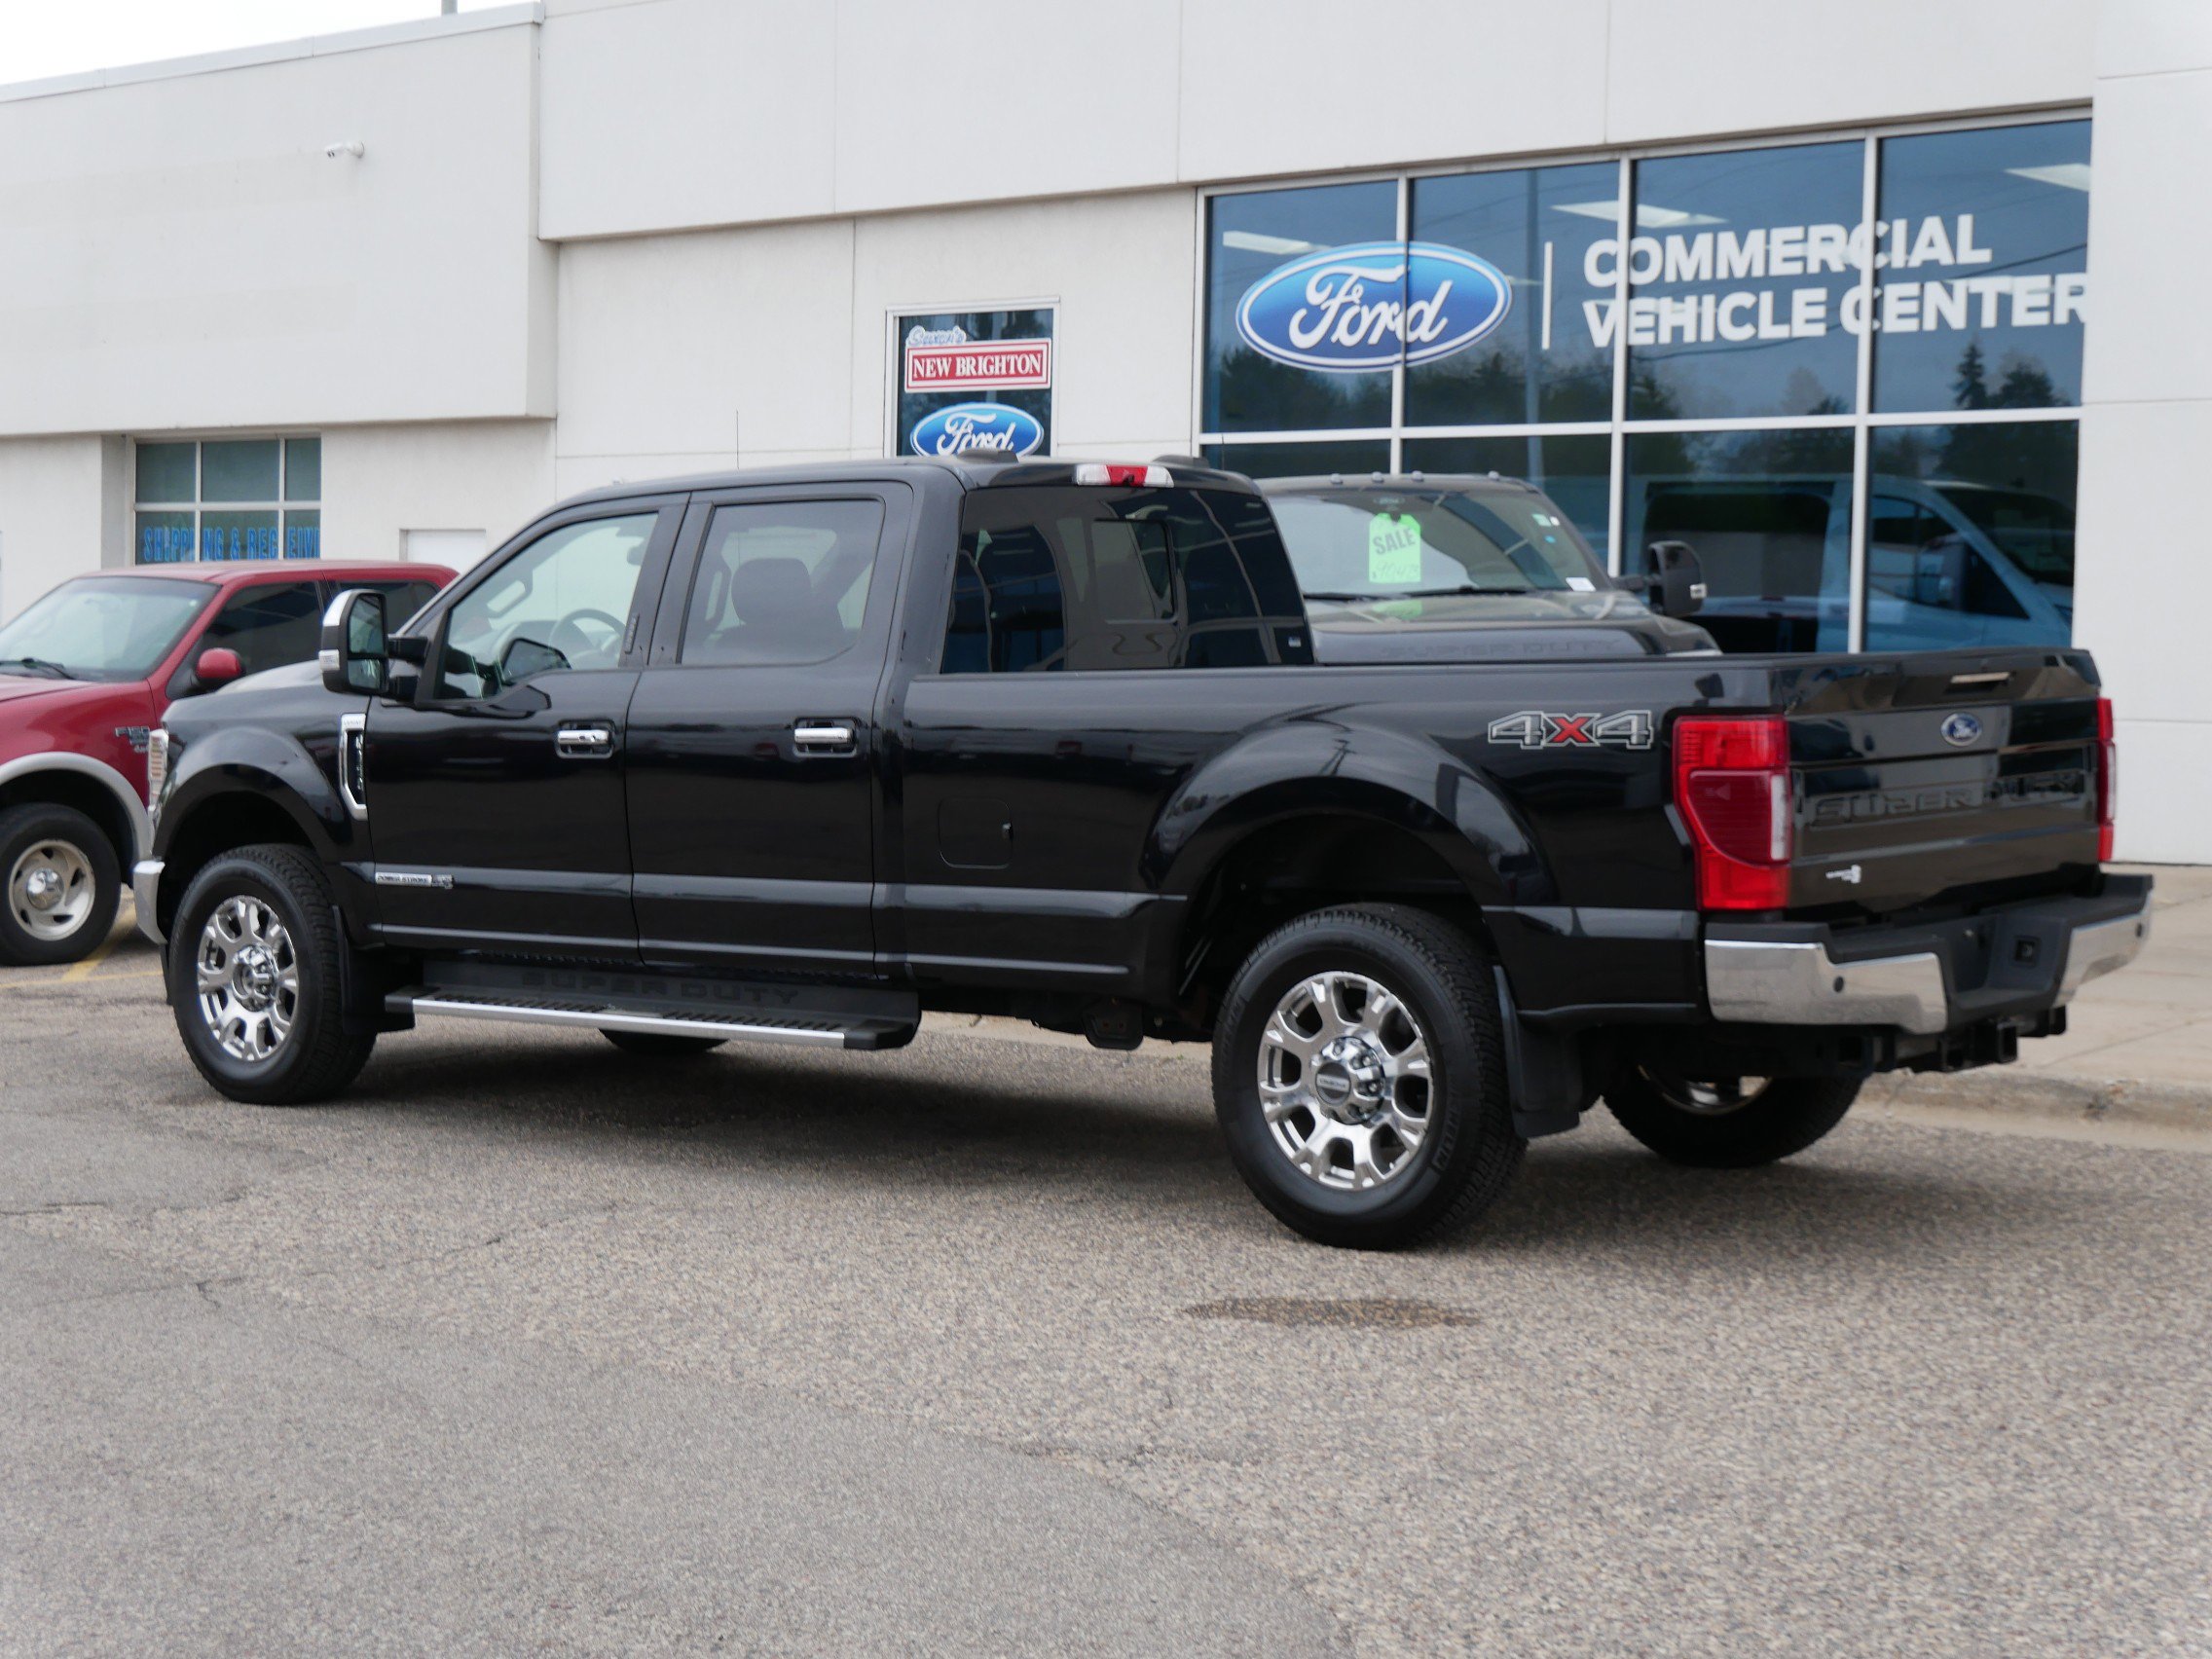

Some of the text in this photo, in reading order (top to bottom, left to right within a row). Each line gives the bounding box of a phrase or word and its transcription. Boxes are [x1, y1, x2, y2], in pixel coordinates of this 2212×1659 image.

[1584, 213, 1993, 287] COMMERCIAL
[1289, 264, 1453, 350] Ford
[1582, 273, 2087, 348] VEHICLE CENTER
[913, 353, 1042, 378] NEW BRIGHTON
[937, 413, 1015, 456] Ford
[144, 526, 224, 562] SHIPPING
[230, 527, 240, 561] &
[1373, 529, 1416, 555] SALE
[522, 971, 799, 1005] SUPER DUTY
